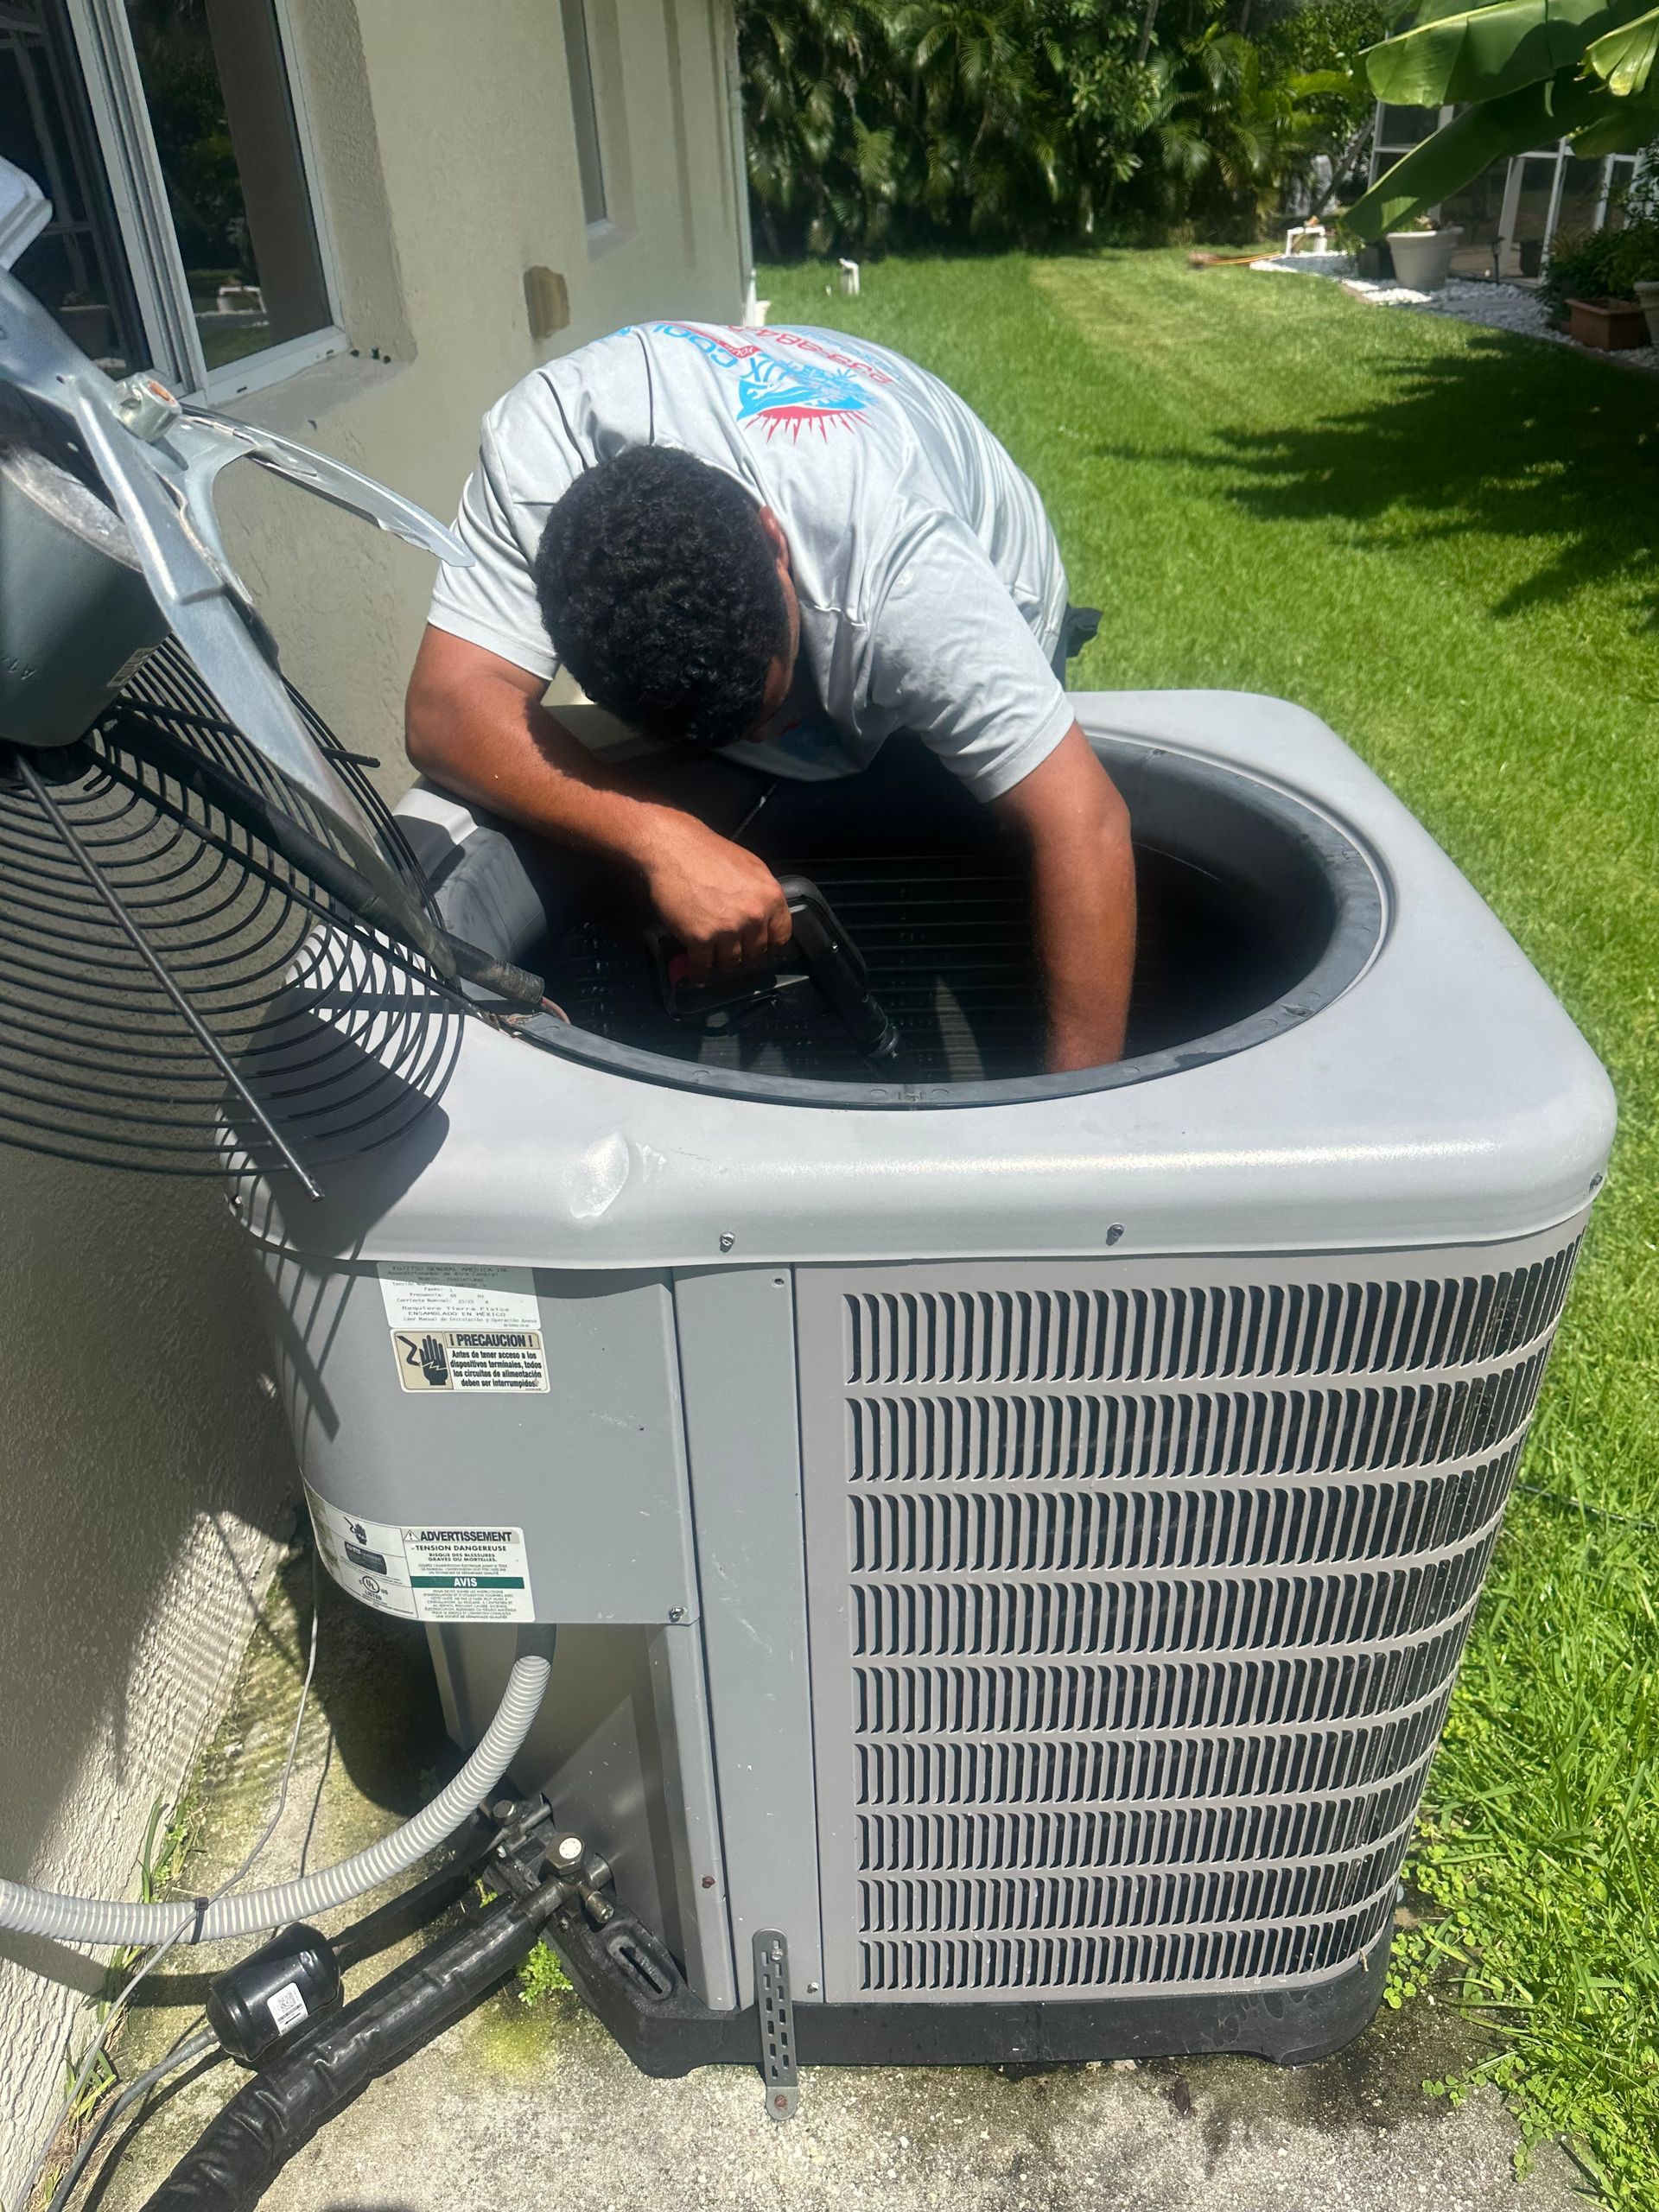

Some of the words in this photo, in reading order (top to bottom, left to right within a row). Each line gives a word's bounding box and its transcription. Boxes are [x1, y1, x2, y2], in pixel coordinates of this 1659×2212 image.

[457, 1334, 526, 1347] PRECAUCION
[450, 1360, 487, 1369] dispositivos
[502, 1370, 542, 1378] alimentación
[421, 1531, 512, 1541] ADVERTISSEMENT
[454, 1577, 478, 1587] AVIS
[365, 1590, 382, 1600] LISTED
